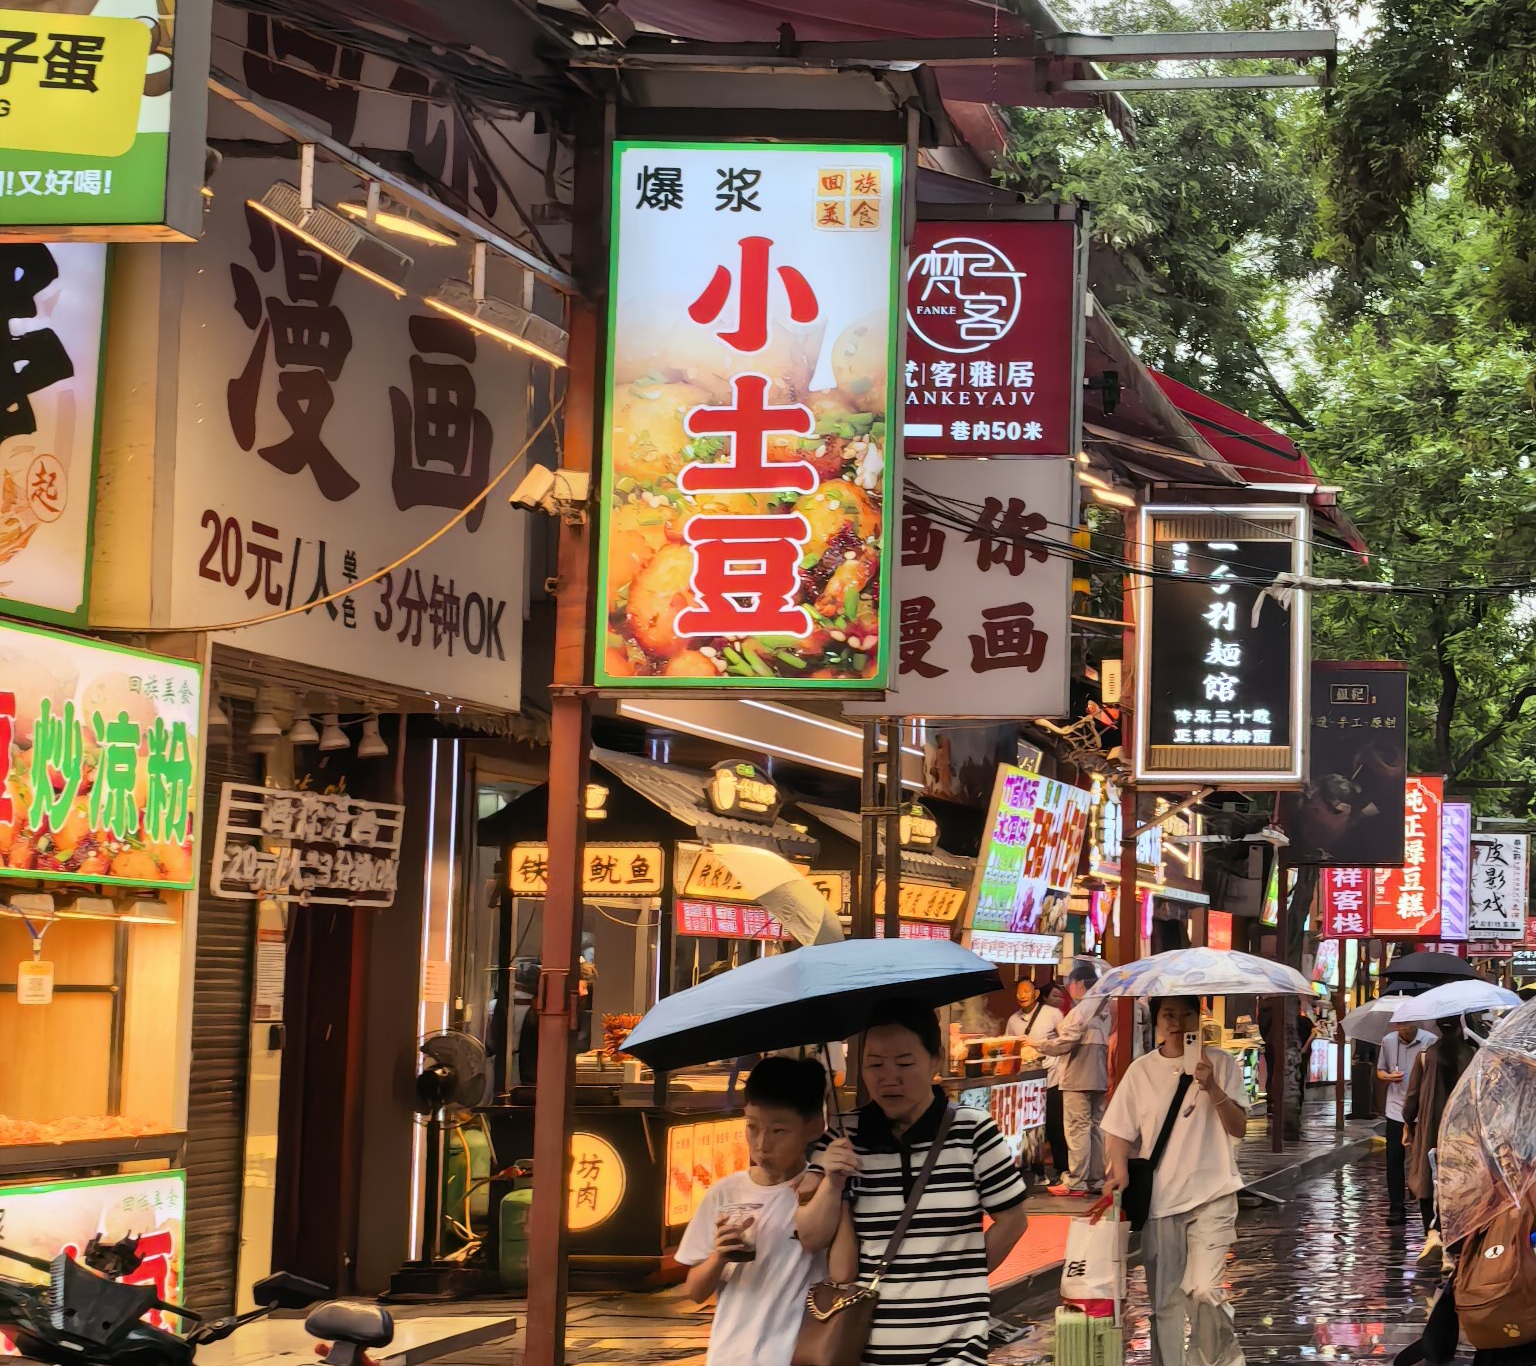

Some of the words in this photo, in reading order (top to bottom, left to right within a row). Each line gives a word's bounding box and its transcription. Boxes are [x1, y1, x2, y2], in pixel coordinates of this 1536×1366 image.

[0, 169, 112, 197] !又好喝!
[636, 165, 762, 213] 爆浆
[820, 172, 881, 197] 回族
[817, 200, 880, 227] 美食
[916, 305, 957, 315] FANKE
[227, 197, 494, 532] 漫画
[674, 235, 820, 638] 小土豆
[950, 420, 1043, 441] 巷内50米
[199, 508, 339, 623] 20元/人
[374, 566, 506, 661] 3分钟OK
[30, 697, 192, 844] 炒凉粉
[518, 853, 655, 885] 铁鱿鱼
[1482, 838, 1509, 919] 皮影戏
